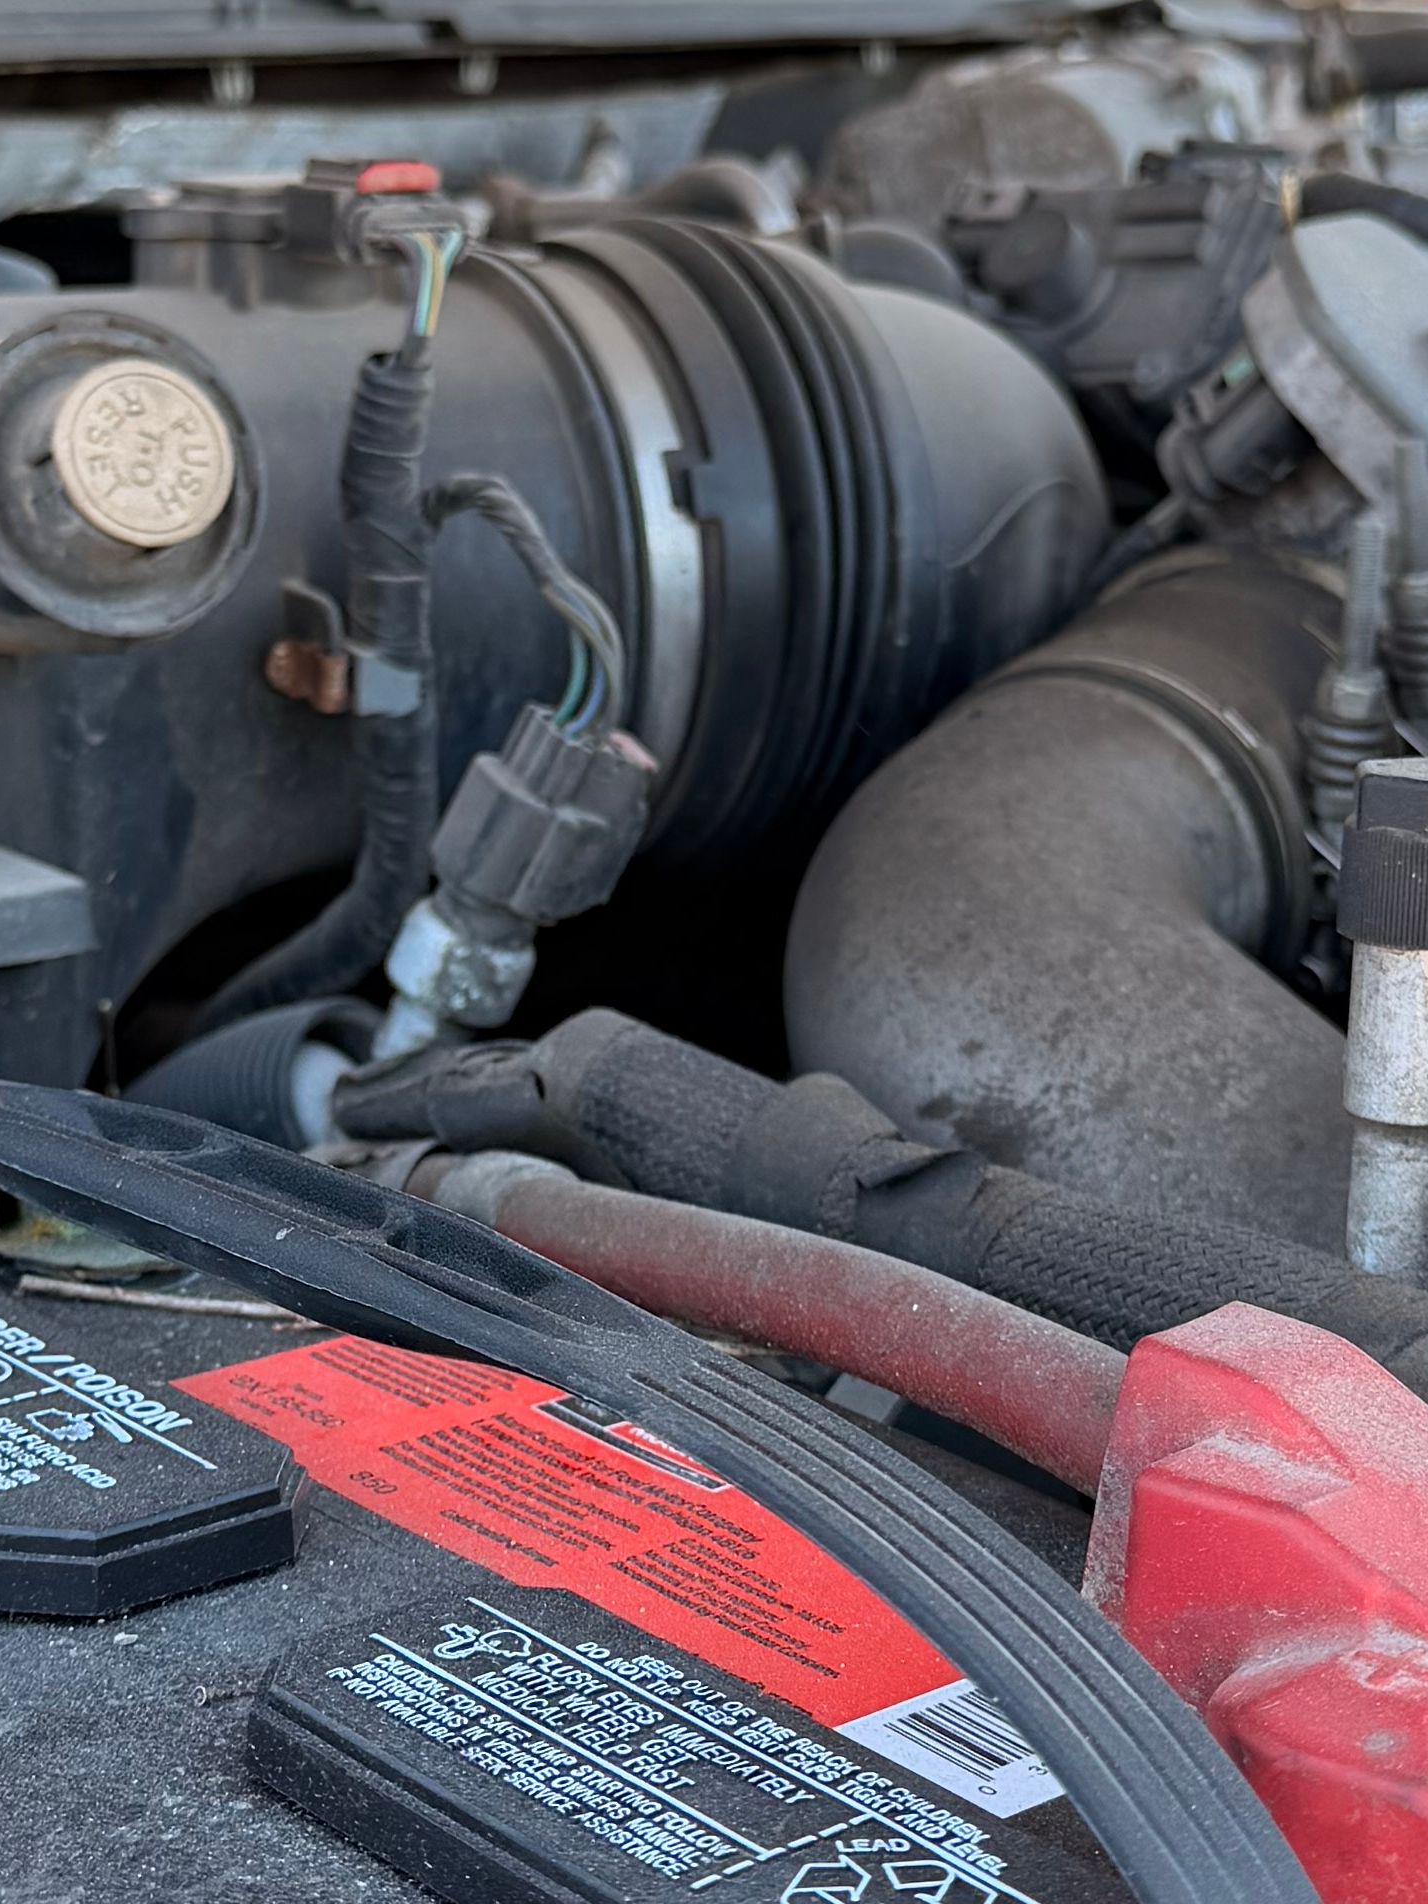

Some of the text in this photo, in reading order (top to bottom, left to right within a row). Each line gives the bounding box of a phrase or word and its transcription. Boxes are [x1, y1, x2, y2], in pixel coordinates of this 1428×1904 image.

[84, 383, 147, 499] RESET
[128, 429, 166, 488] TO
[154, 410, 211, 516] PUSH
[64, 1462, 117, 1489] ACID
[322, 1665, 357, 1680] IF
[339, 1676, 390, 1702] NOT
[498, 1660, 567, 1696] WITH
[637, 1737, 697, 1767] GET
[350, 1660, 471, 1729] INSTRUCTIONS
[459, 1725, 491, 1741] IN
[481, 1737, 561, 1780] VEHICLE
[546, 1774, 636, 1820] OWNERS
[371, 1652, 738, 1857] CAUTION: FOR SAFE JUMP STARTING FOLLOW
[456, 1745, 512, 1775] SEEK
[469, 1670, 696, 1792] MEDICAL HELP FAST
[524, 1651, 815, 1805] FLUSH EYES IMMEDIATELY
[573, 1640, 614, 1660] DO
[602, 1656, 653, 1682] NOT
[680, 1698, 739, 1728] KEEP
[730, 1726, 791, 1756] VENT
[779, 1752, 843, 1782] CAPS
[833, 1779, 905, 1815] TIGHT
[893, 1811, 950, 1839] AND
[938, 1837, 1016, 1875] LEVEL
[630, 1654, 994, 1844] KEEP OUT OF THE REACH OF CHILDREN
[500, 1770, 582, 1813] SERVICE
[570, 1810, 695, 1879] ASSISTANCE.
[834, 1834, 911, 1856] LEAD
